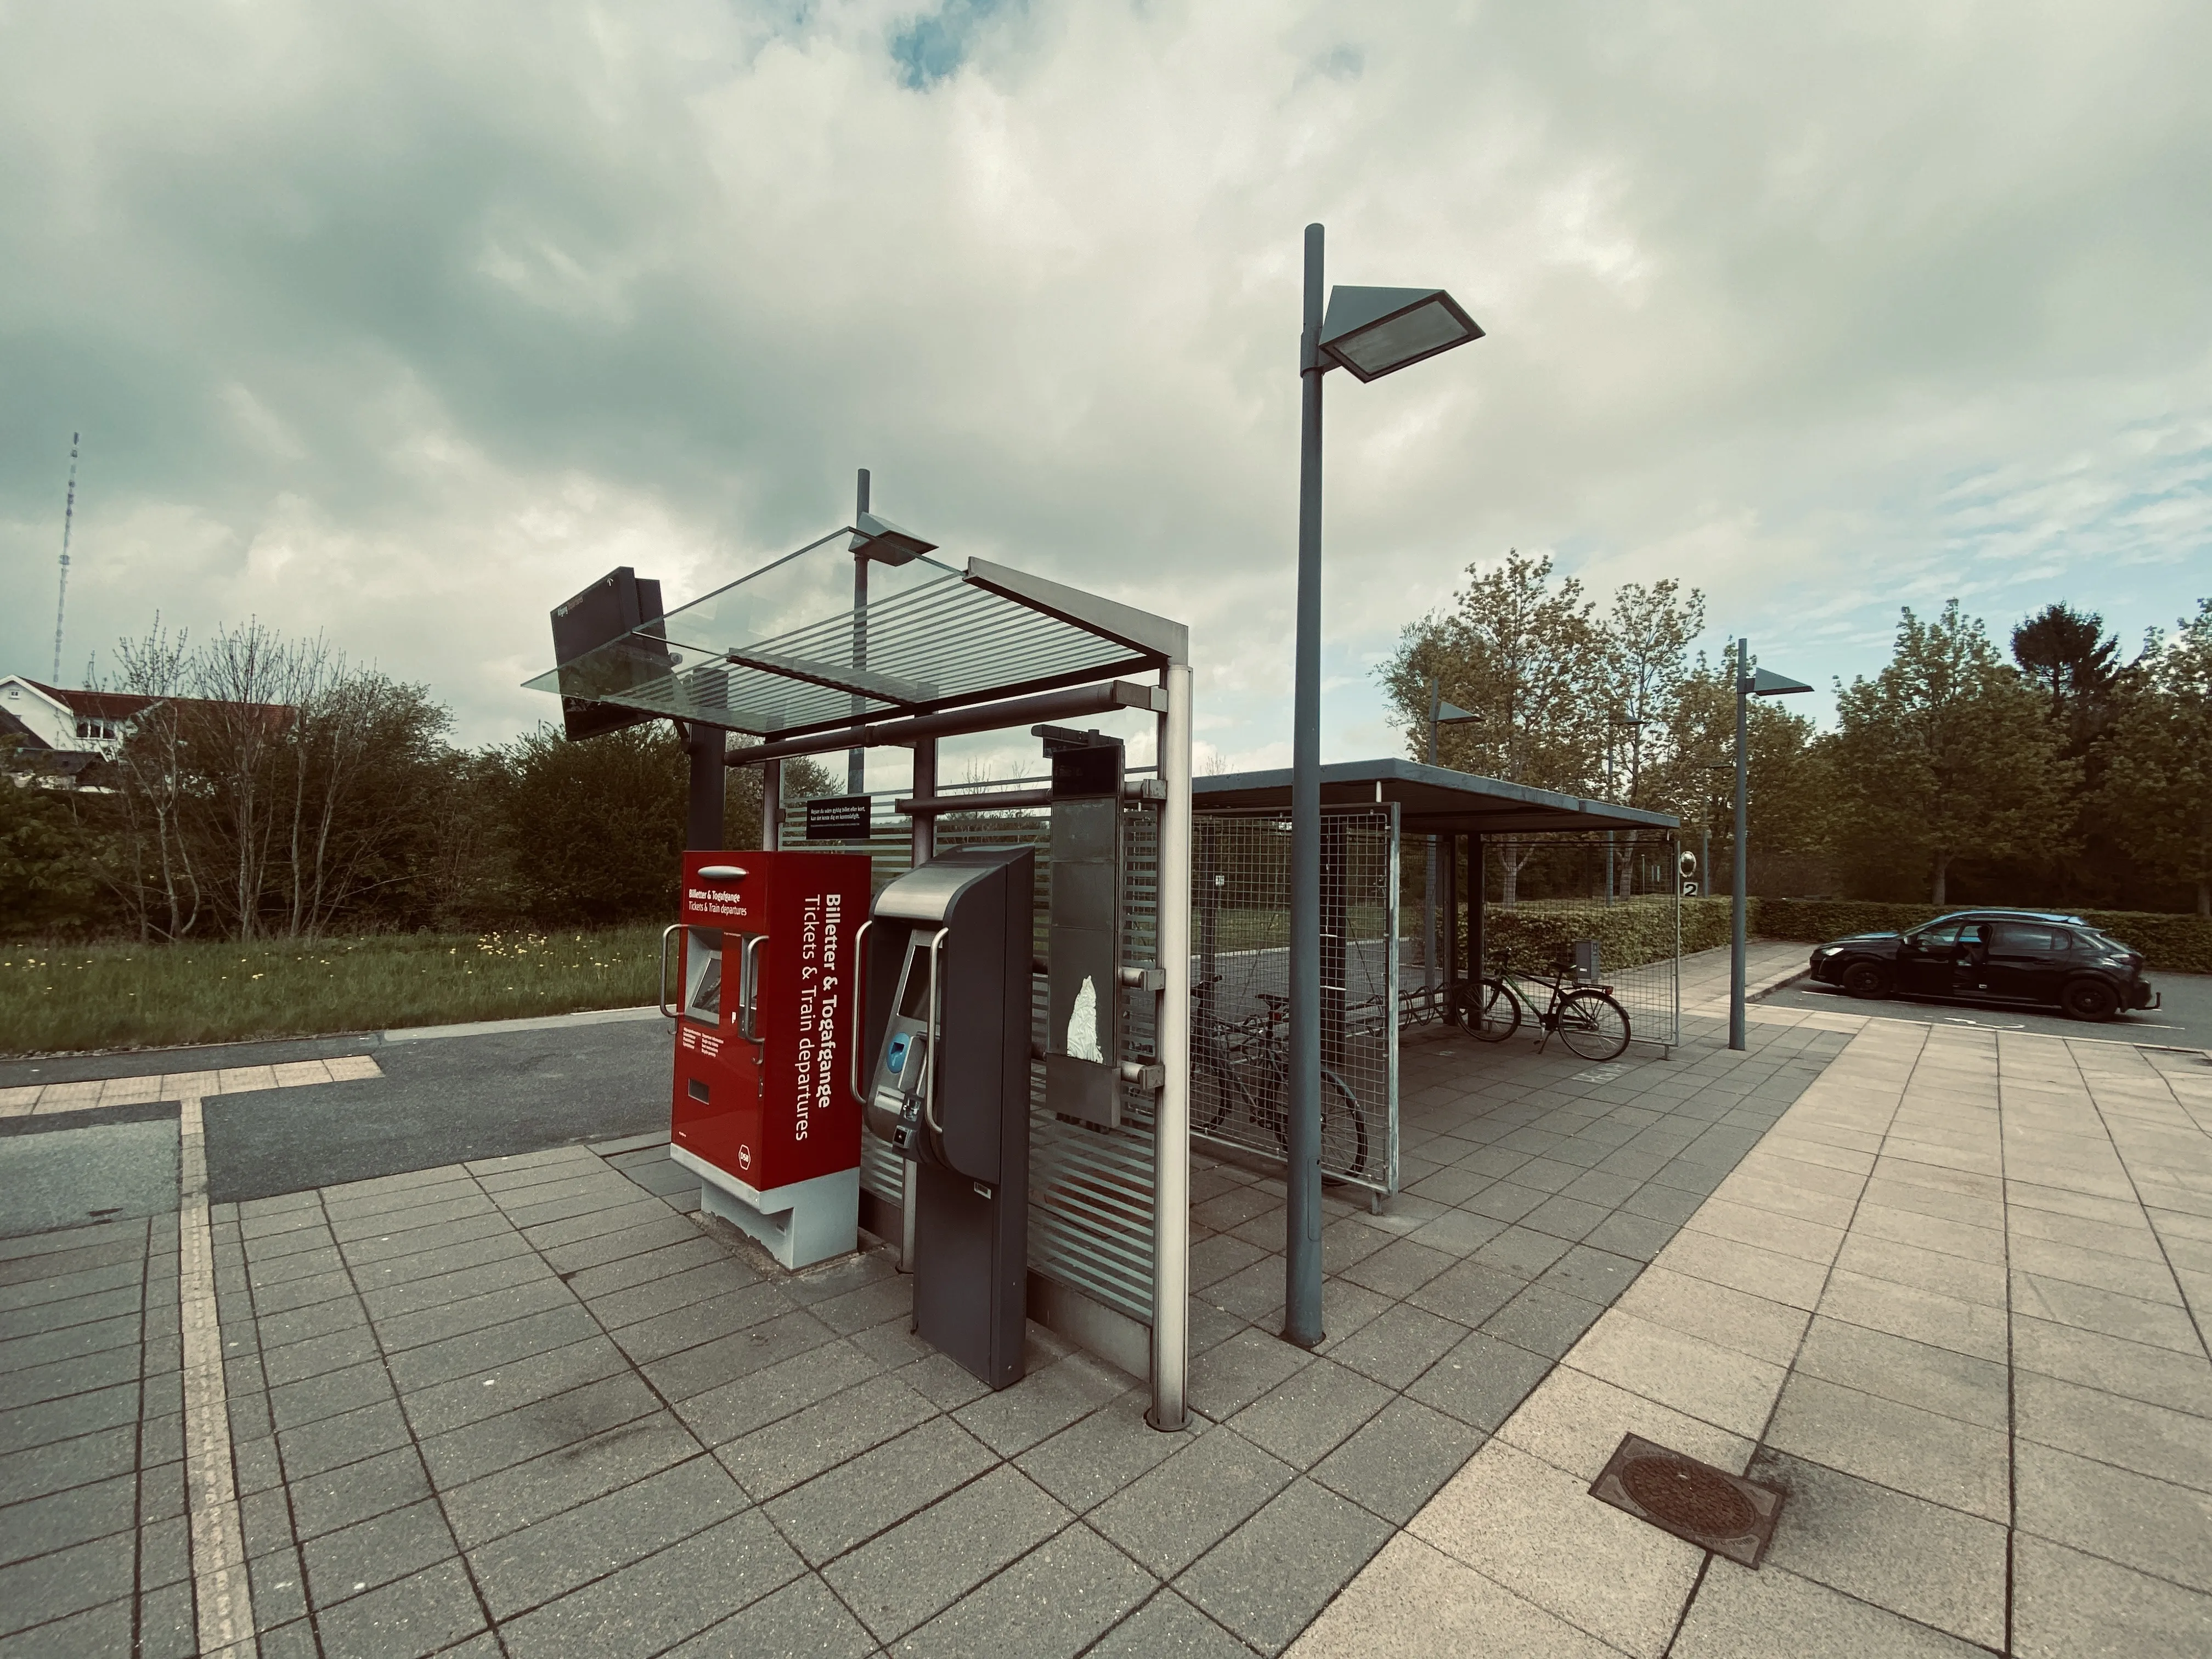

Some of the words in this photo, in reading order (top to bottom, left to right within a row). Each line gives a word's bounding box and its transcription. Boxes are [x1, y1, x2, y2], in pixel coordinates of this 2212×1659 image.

[689, 889, 707, 899] Billetter
[707, 890, 712, 900] &
[712, 890, 740, 904] Togafgange
[1684, 884, 1696, 897] 2
[689, 901, 703, 911] Tickets
[704, 902, 708, 912] &
[709, 903, 720, 913] Train
[720, 904, 747, 916] departures
[803, 894, 820, 960] Tickets
[823, 894, 840, 970] Billetter
[802, 966, 817, 980] &
[823, 976, 838, 991] &
[800, 985, 817, 1031] Train
[816, 995, 837, 1108] Togafgange
[795, 1038, 815, 1141] departures
[741, 1152, 749, 1162] DSB
